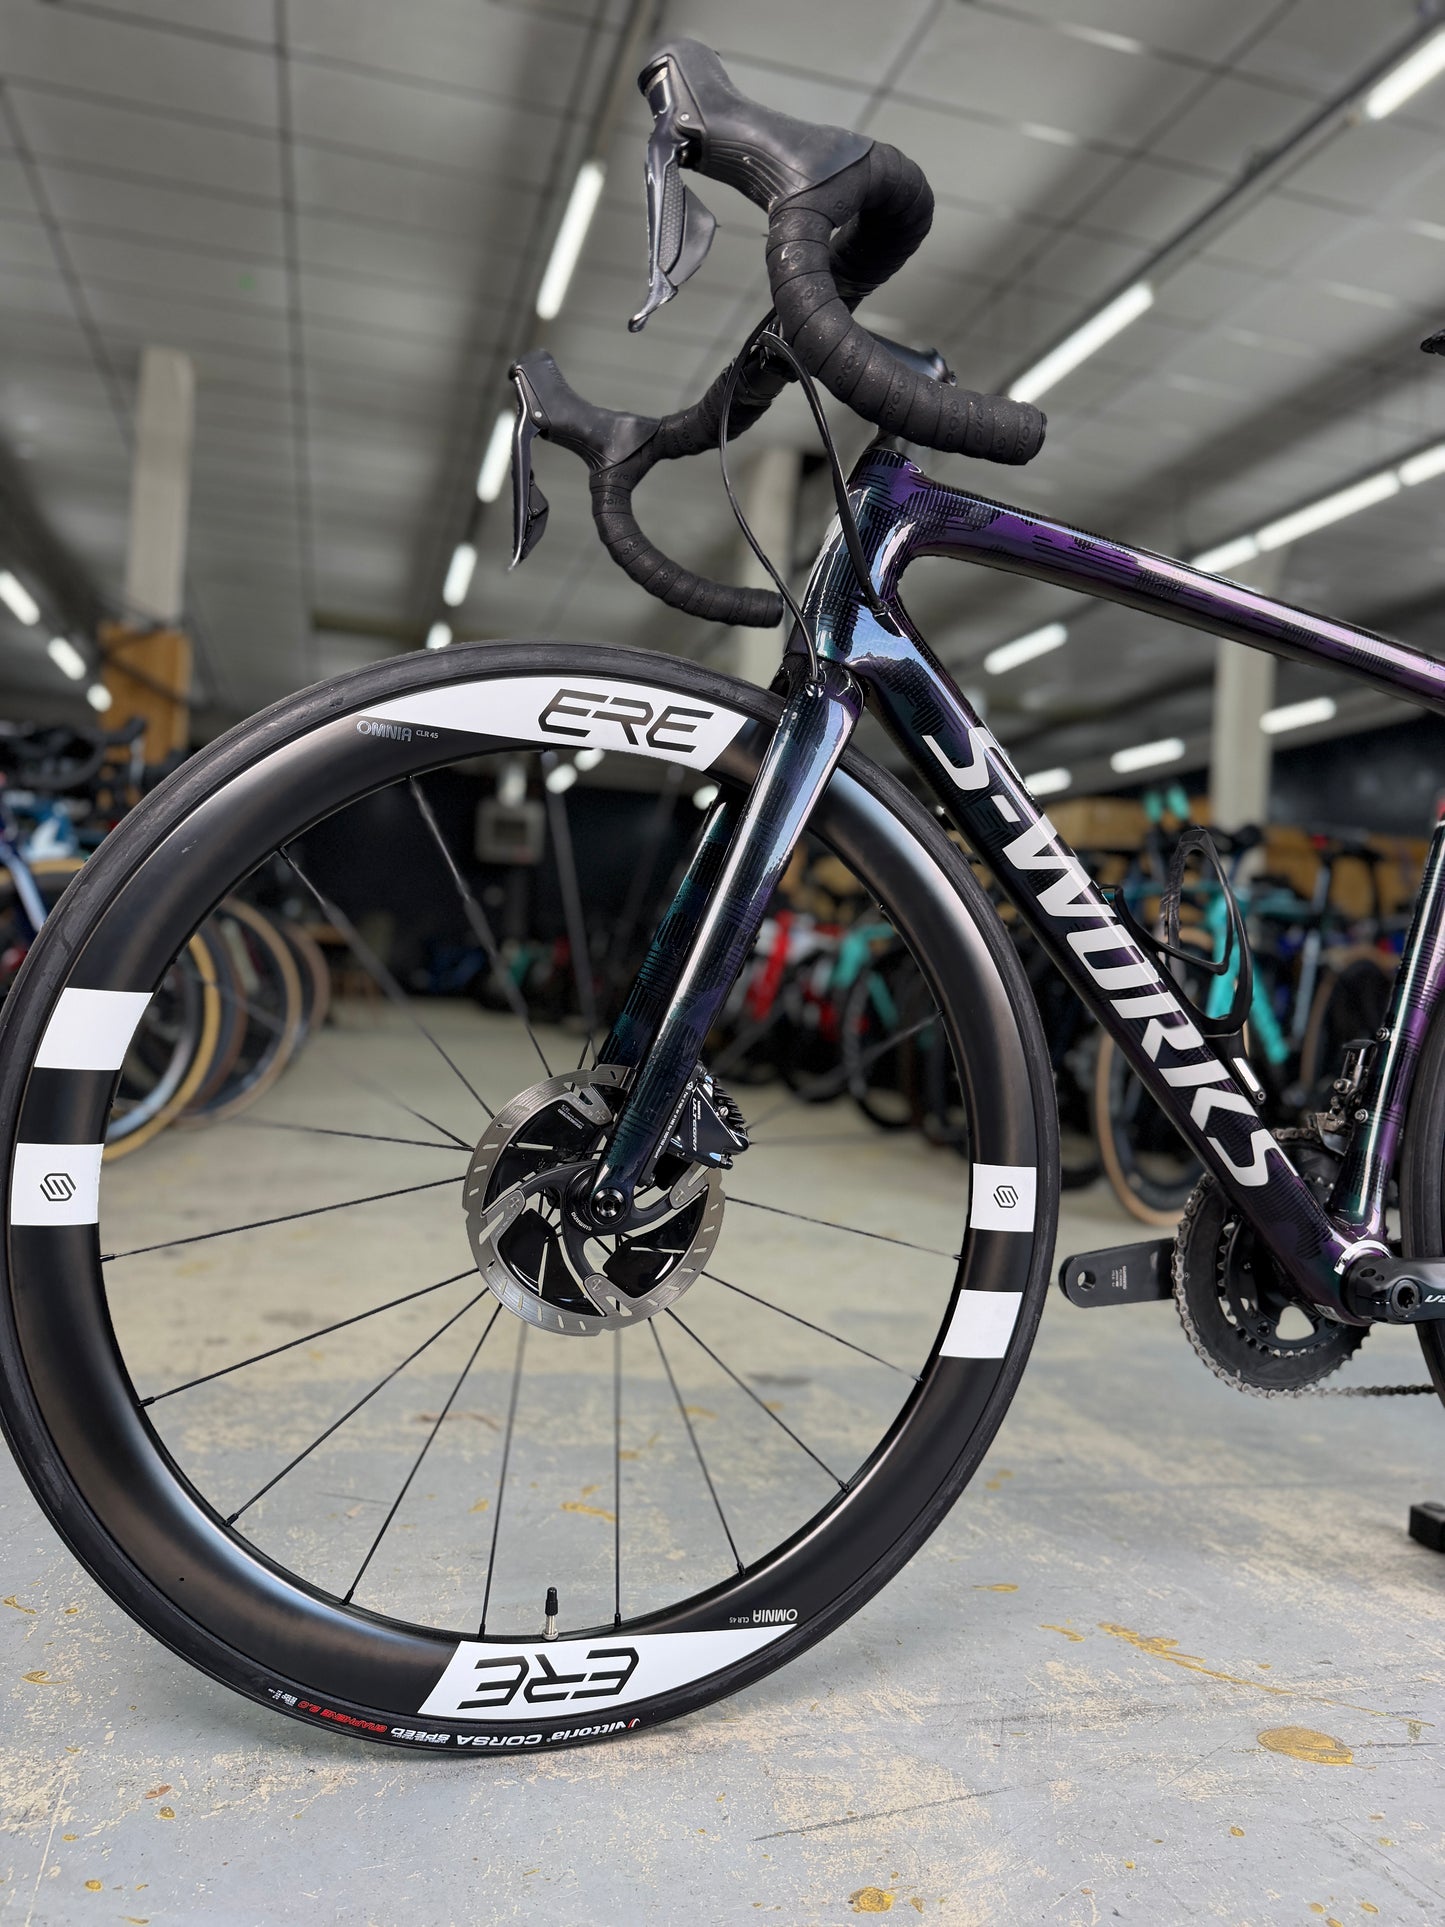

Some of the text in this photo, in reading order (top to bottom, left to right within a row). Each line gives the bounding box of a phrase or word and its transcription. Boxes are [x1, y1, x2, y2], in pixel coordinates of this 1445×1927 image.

[356, 720, 412, 742] OMNIA
[415, 729, 429, 738] CLR
[537, 688, 714, 753] ERE
[922, 726, 1299, 1188] S-WORKS
[729, 1608, 798, 1624] OMNIA CLR 45
[456, 1647, 640, 1710] ERE
[320, 1708, 388, 1733] GRAPHENE
[390, 1719, 627, 1747] vittoria CORSA SPEED
